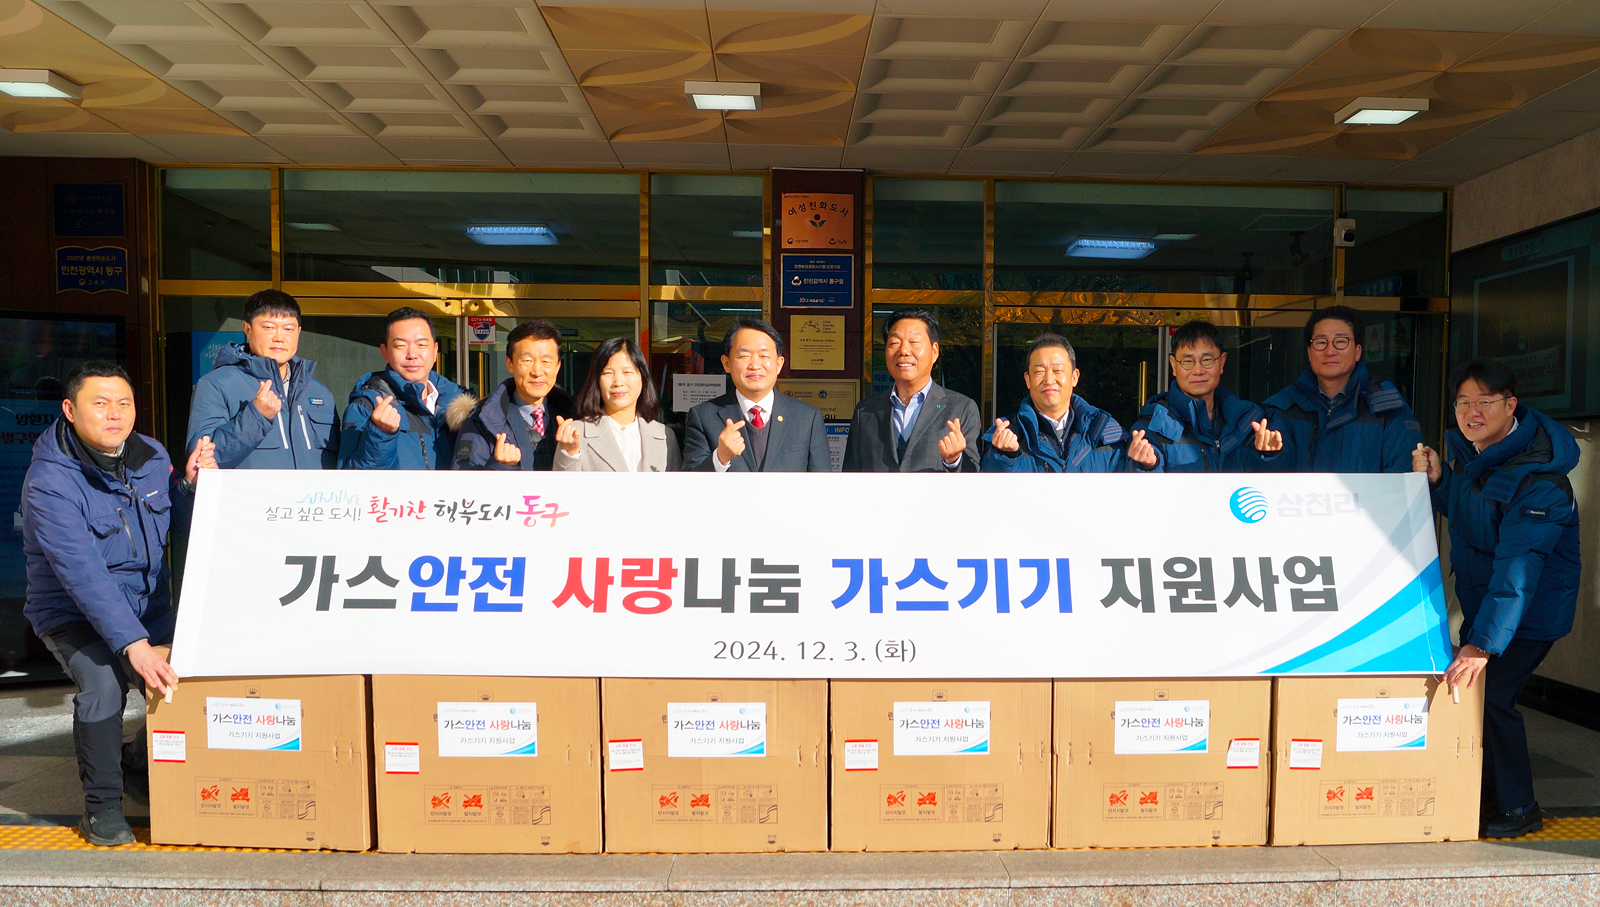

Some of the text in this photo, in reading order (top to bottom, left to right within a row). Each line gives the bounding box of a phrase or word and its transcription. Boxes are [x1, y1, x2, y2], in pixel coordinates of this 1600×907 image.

[788, 201, 849, 218] 여성친화도시
[61, 266, 122, 276] 인천광역시 동구
[16, 413, 55, 426] 암환자
[1276, 492, 1361, 517] 삼천리
[265, 494, 570, 528] 살고 싶은 도시! 활기찬 행복도시 동구
[279, 555, 1338, 615] 가스안전 사랑나눔 가스기기 지원사업
[713, 639, 917, 664] 2024. 12. 3. (화)
[212, 713, 297, 726] 가스안전 사랑나눔
[444, 719, 532, 731] 가스안전 사랑나눔
[673, 719, 761, 731] 가스안전 사랑나눔
[899, 718, 985, 730] 가스안전 사랑나눔
[1120, 716, 1205, 729] 가스안전 사랑나눔
[1342, 713, 1423, 726] 가스안전 사랑나눔
[228, 731, 281, 740] 가스기기 지원사업
[690, 736, 716, 744] 가스기기
[914, 735, 941, 743] 가스기기
[1136, 734, 1188, 742] 가스기기 지원사업
[1357, 731, 1382, 739] 가스기기
